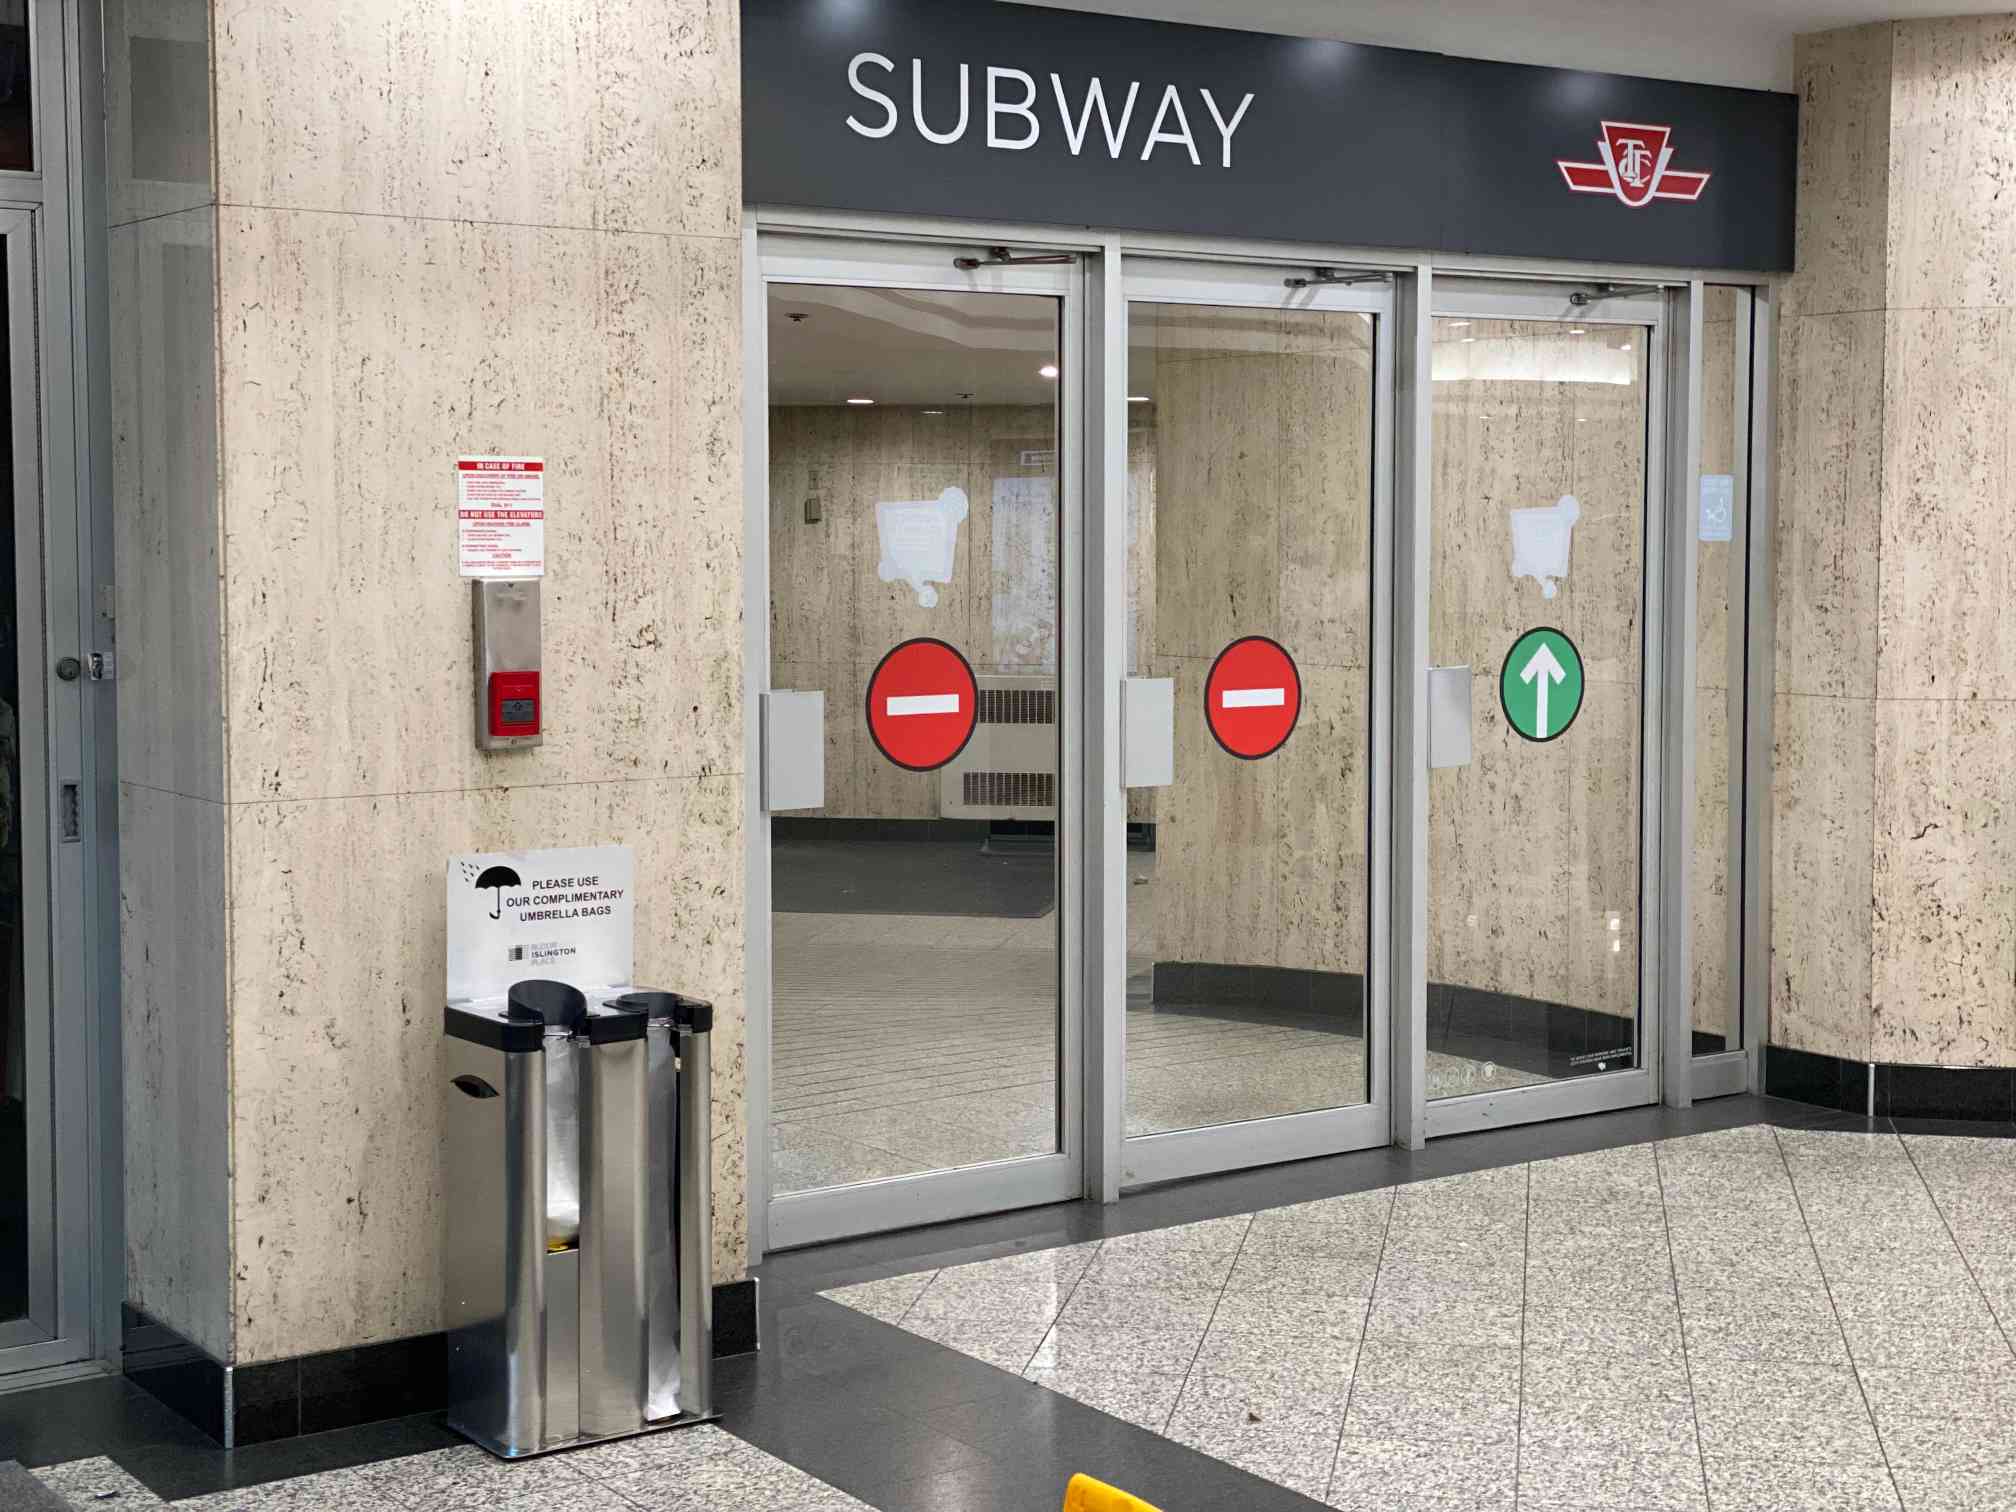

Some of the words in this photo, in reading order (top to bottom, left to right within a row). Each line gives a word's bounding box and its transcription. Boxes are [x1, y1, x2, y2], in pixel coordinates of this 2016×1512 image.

[845, 51, 1255, 168] SUBWAY
[485, 462, 500, 470] CASE
[502, 463, 510, 471] OF
[512, 463, 526, 471] FIRE
[497, 511, 508, 519] THE
[532, 878, 574, 890] PLEASE
[577, 876, 599, 887] USE
[506, 896, 530, 908] OUR
[534, 889, 624, 906] COMPLIMENTARY
[519, 909, 579, 922] UMBRELLA
[581, 905, 612, 917] BAGS
[531, 947, 576, 958] ISLINGTON
